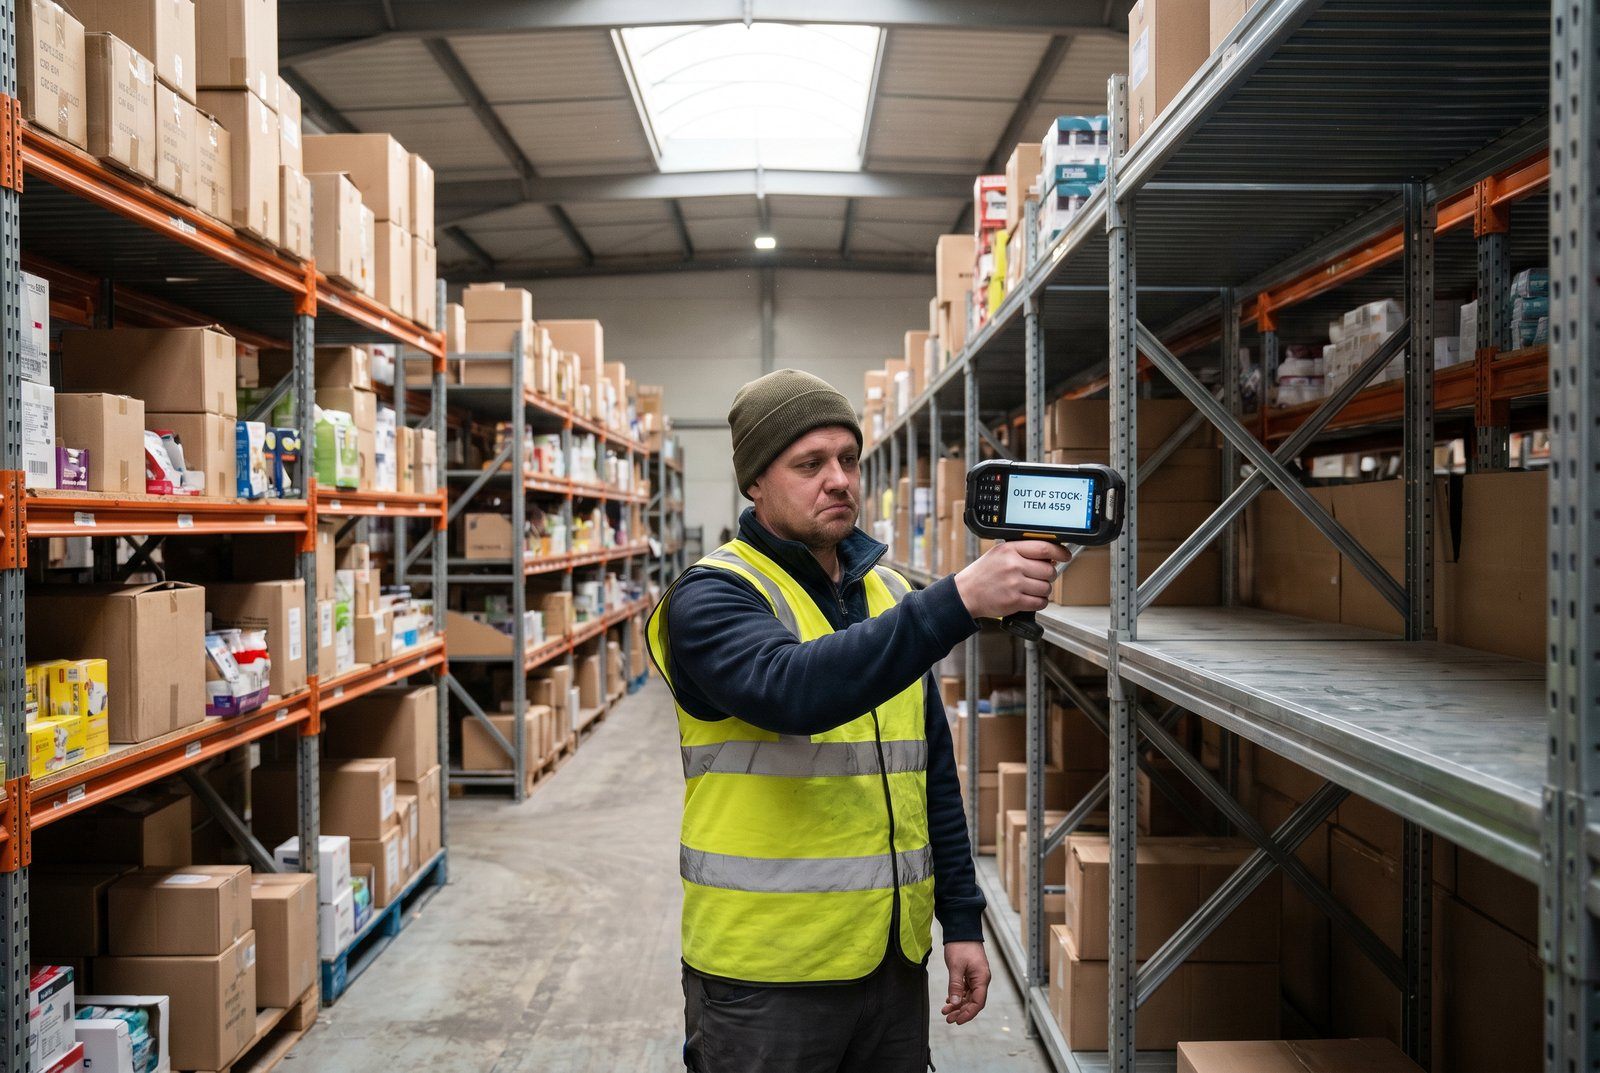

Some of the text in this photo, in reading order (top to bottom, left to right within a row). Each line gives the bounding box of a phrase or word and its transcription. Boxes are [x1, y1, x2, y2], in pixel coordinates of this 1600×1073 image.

[1014, 489, 1032, 497] OUT
[1048, 491, 1082, 500] STOCK:
[1023, 501, 1071, 511] ITEM 4559
